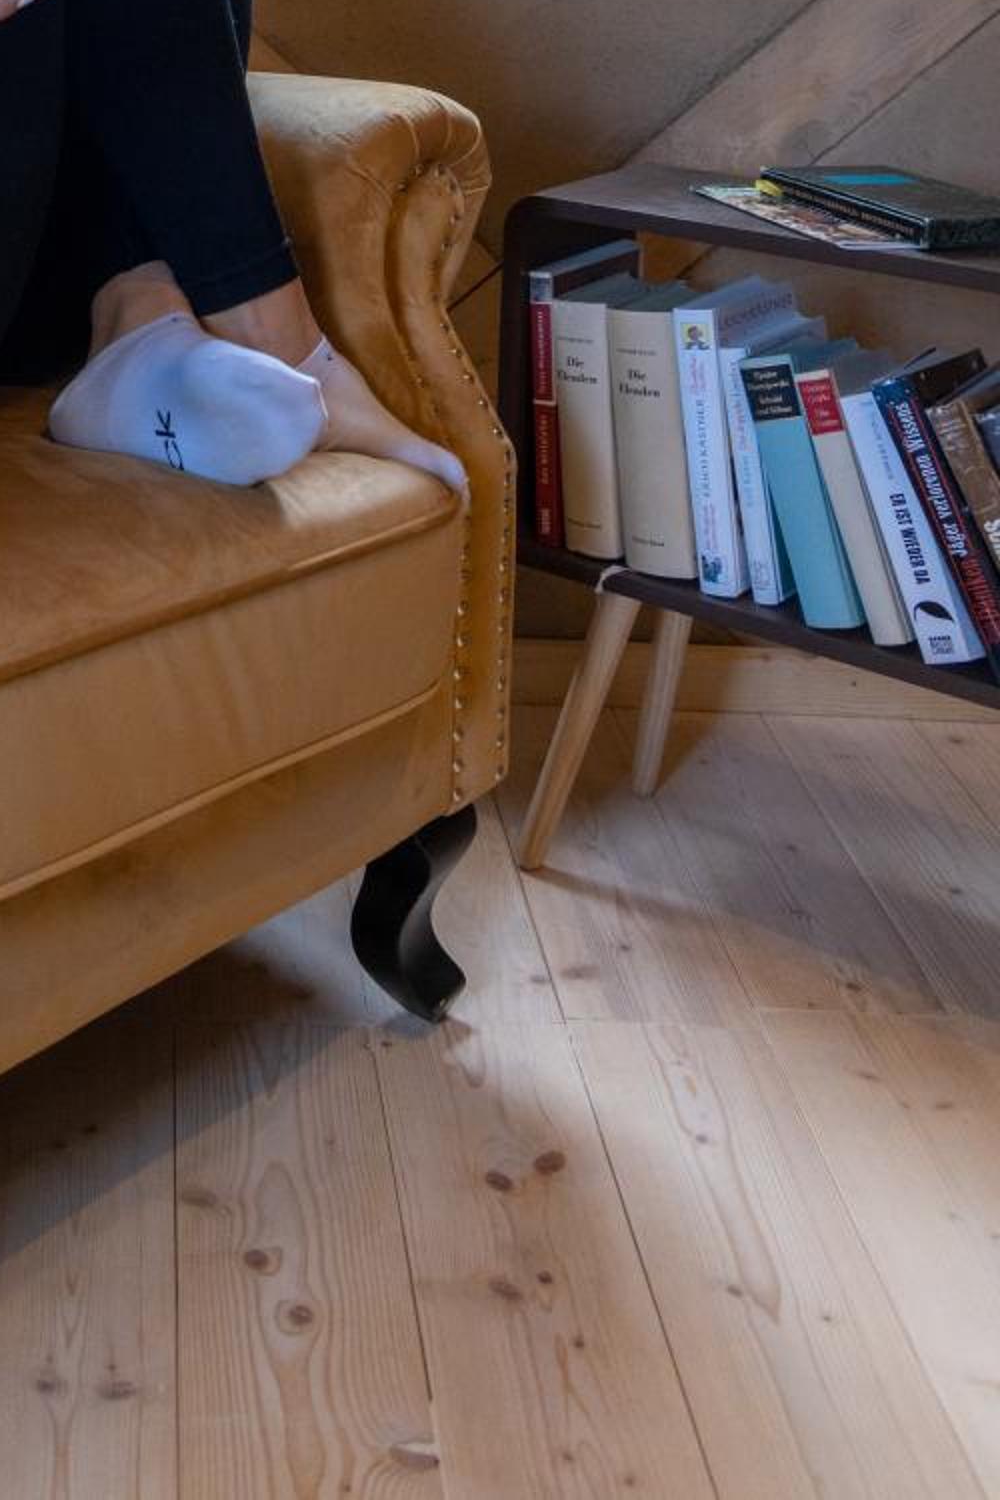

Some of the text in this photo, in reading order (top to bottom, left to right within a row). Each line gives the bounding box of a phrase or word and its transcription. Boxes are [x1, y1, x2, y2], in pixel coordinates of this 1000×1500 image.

[567, 356, 584, 368] Die
[627, 368, 646, 380] Die
[896, 401, 926, 452] Wissens
[916, 454, 953, 520] verlorenen
[889, 492, 931, 585] ER IST WIEDER DA
